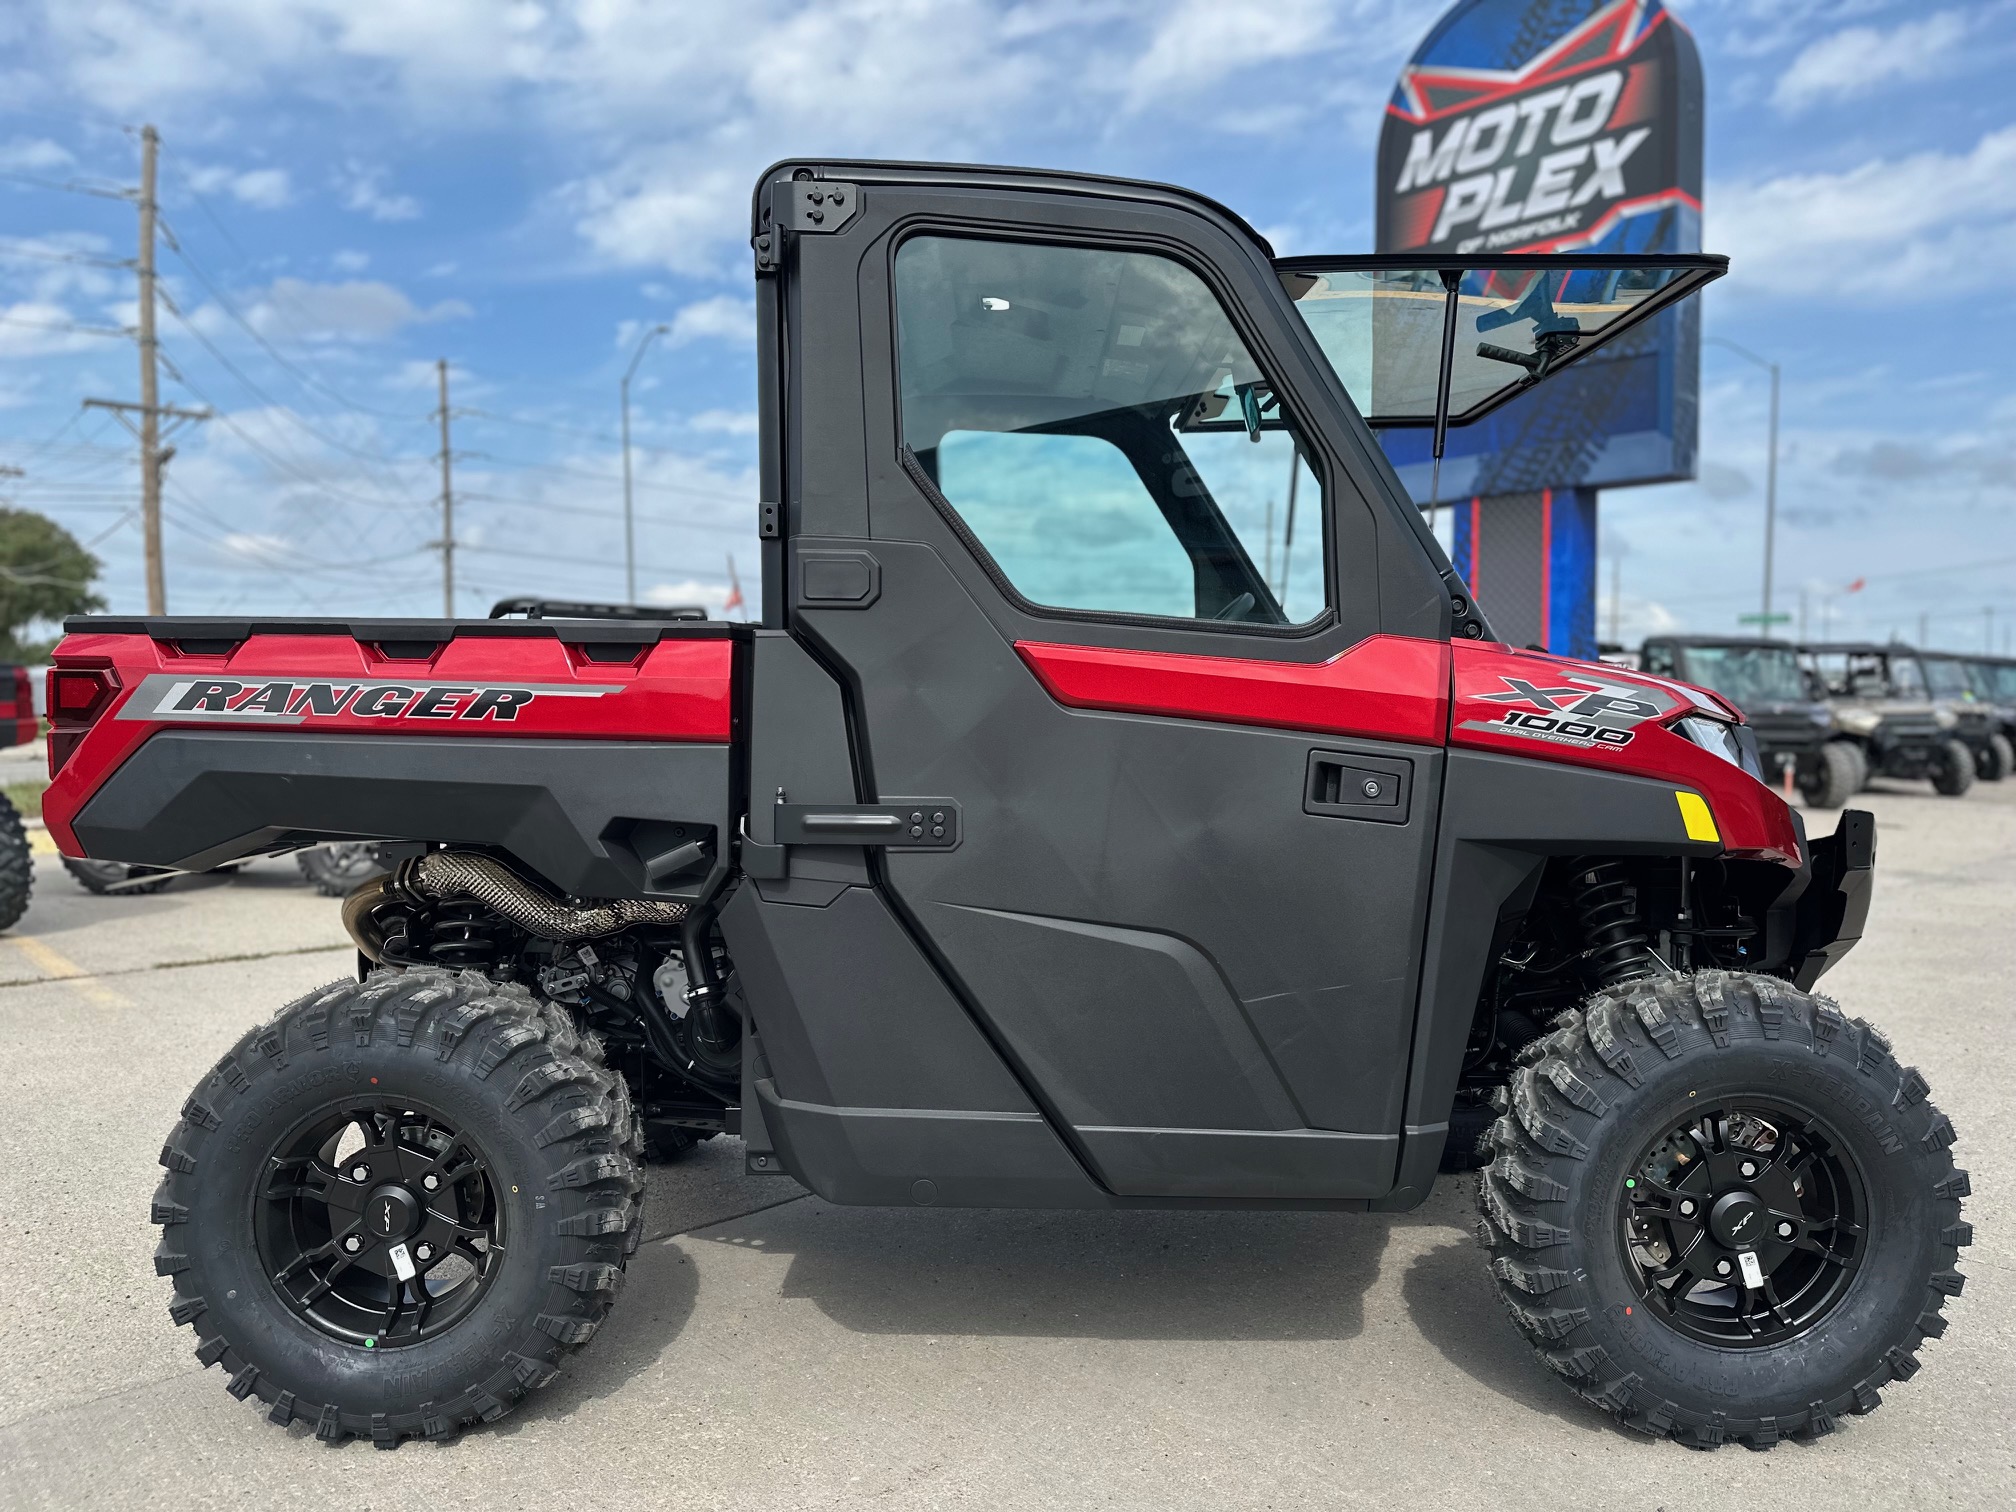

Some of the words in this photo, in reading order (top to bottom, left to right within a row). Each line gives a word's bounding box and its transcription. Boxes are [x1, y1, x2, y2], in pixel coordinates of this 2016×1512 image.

[1395, 70, 1623, 193] MOTO
[1430, 126, 1652, 243] PLEX
[172, 679, 534, 722] RANGER
[1467, 675, 1663, 719] XP
[1499, 709, 1636, 746] 1000
[1499, 726, 1530, 737] DUAL
[1531, 732, 1596, 748] OVERHEAD
[1597, 744, 1624, 753] CAM
